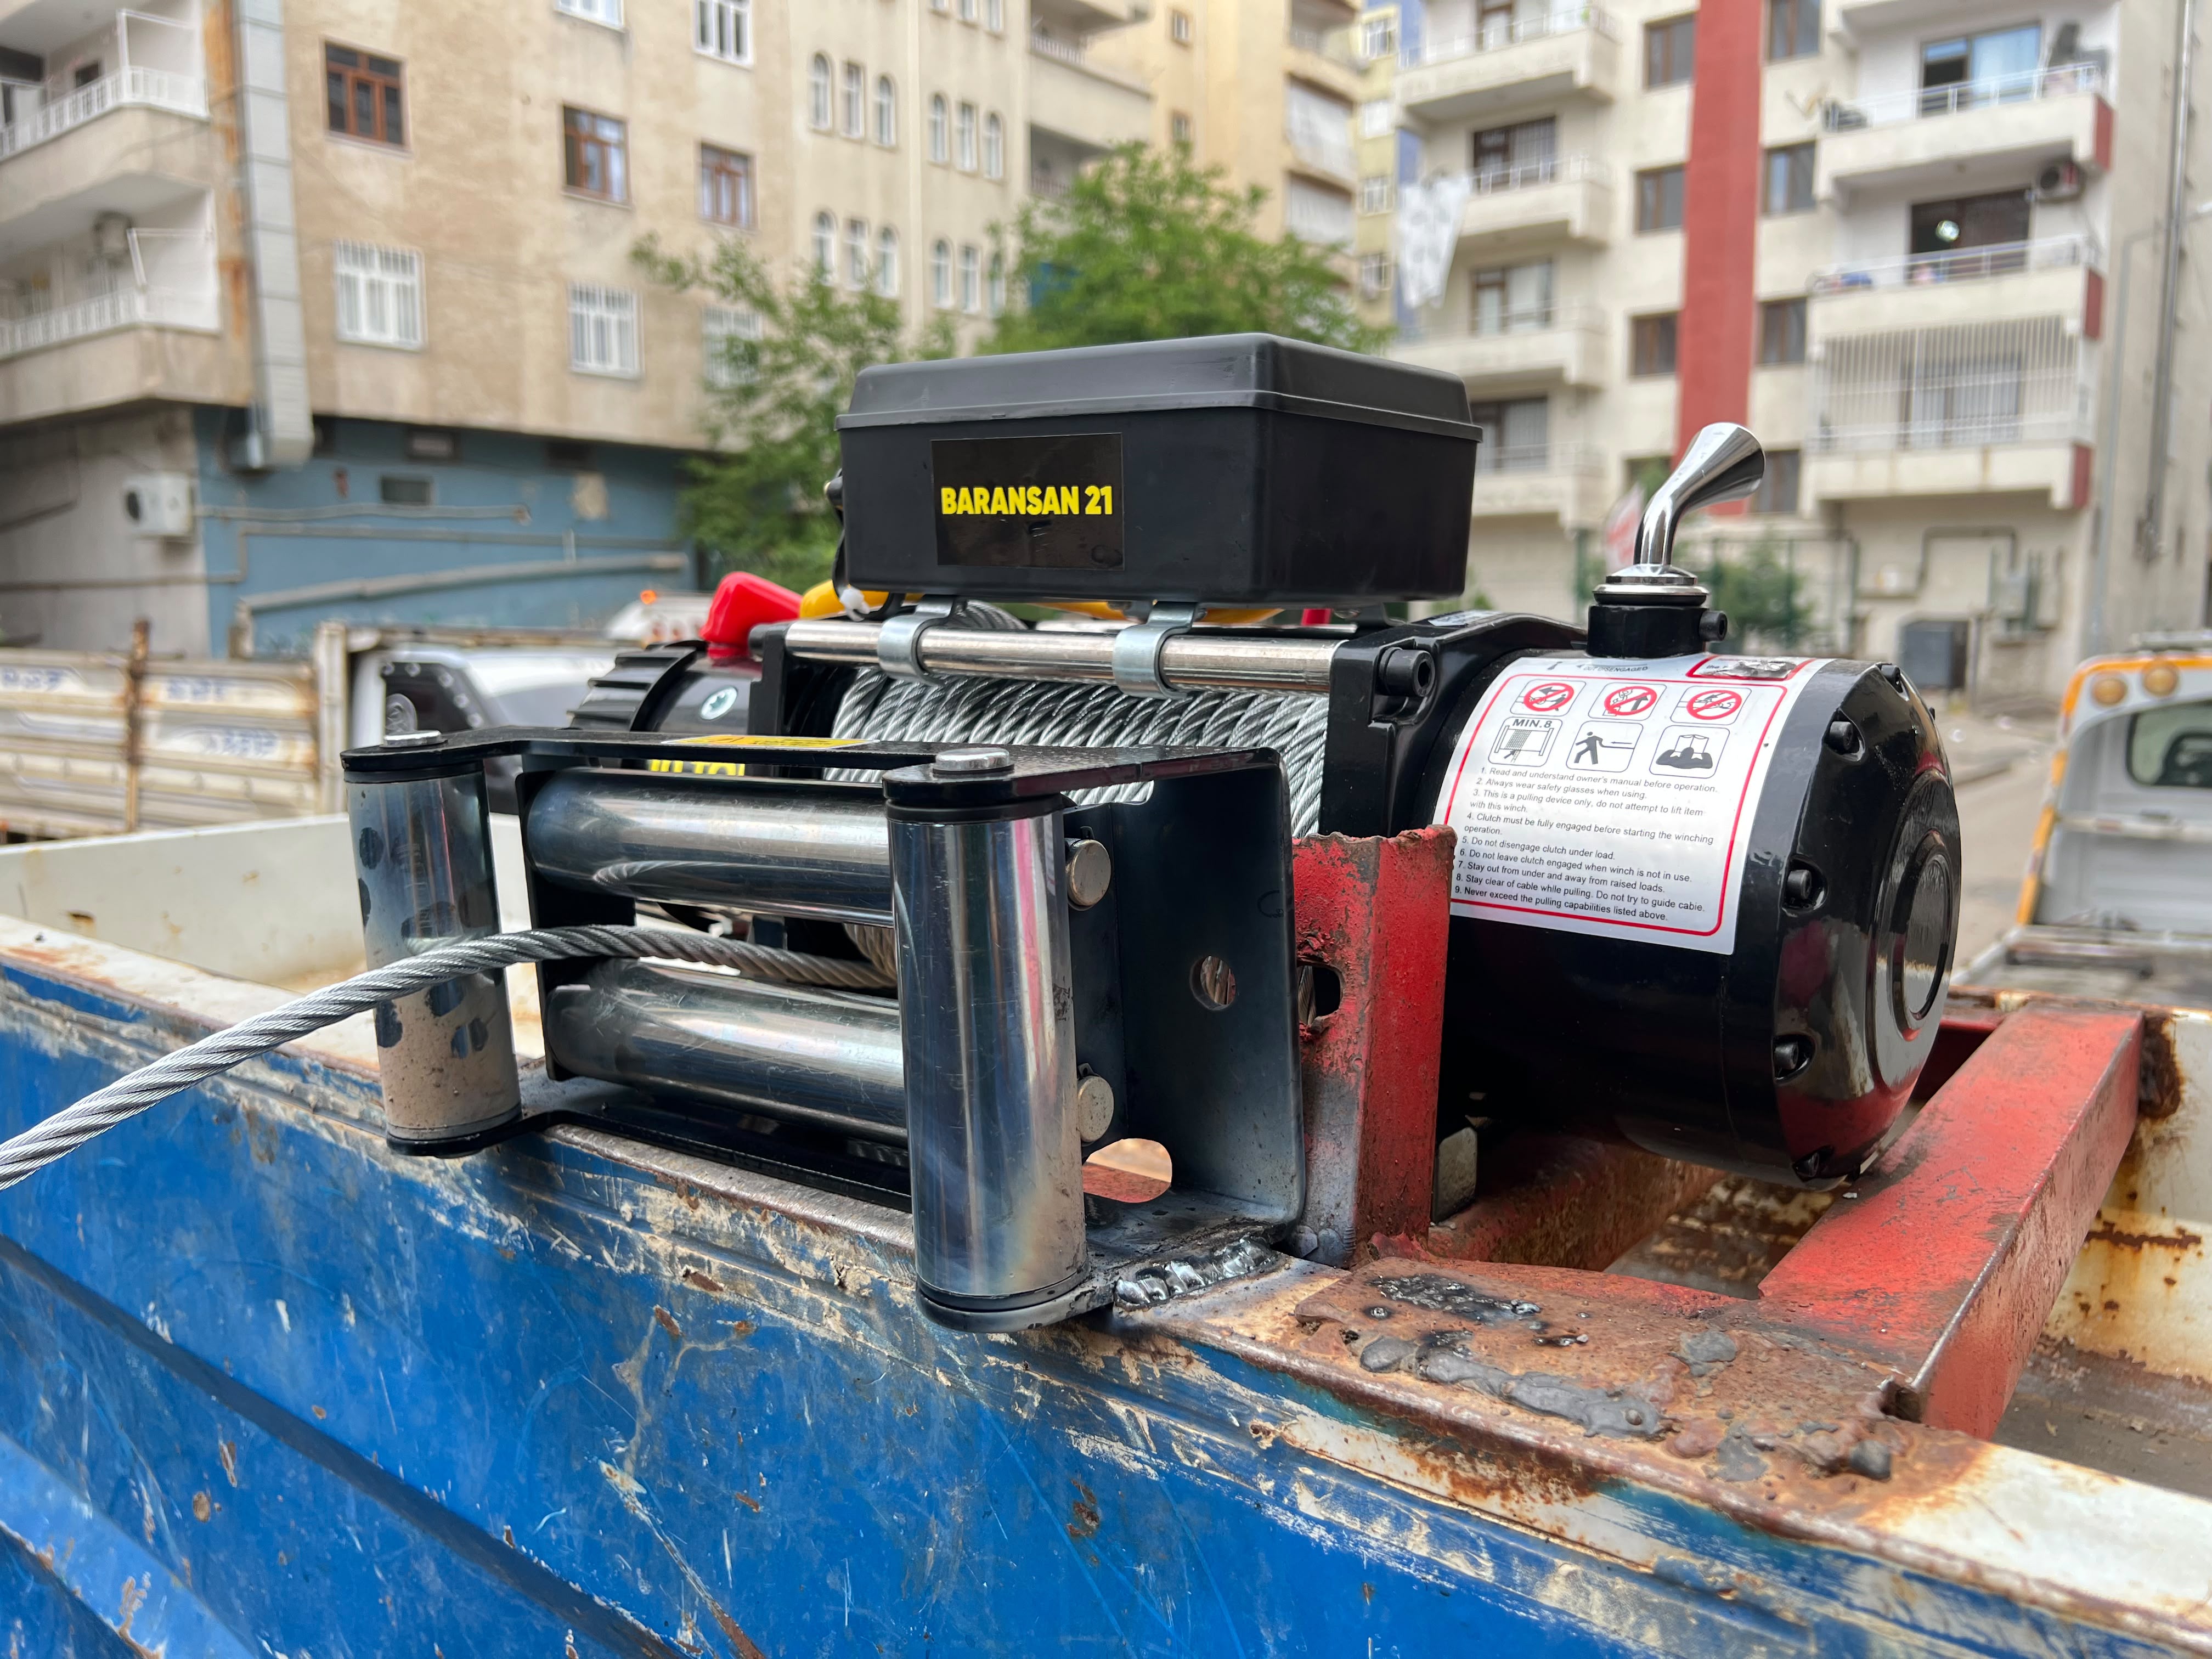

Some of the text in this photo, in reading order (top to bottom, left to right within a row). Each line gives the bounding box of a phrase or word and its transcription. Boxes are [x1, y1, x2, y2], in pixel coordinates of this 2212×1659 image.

[941, 485, 1113, 515] BARANSAN 21
[1485, 777, 1514, 788] Always
[1536, 782, 1562, 793] safety
[1562, 785, 1594, 794] glasses
[1596, 787, 1620, 796] when
[1621, 789, 1646, 800] using.
[1488, 766, 1511, 776] Read
[1528, 771, 1575, 781] understand
[1576, 775, 1608, 784] owner's
[1609, 778, 1642, 786] manual
[1643, 778, 1672, 789] before
[1673, 783, 1717, 792] operation.
[1469, 800, 1528, 812] with this winch.
[1483, 789, 1499, 798] This
[1500, 791, 1508, 799] is
[1516, 793, 1543, 804] pulling
[1545, 794, 1572, 804] device
[1573, 798, 1593, 808] only,
[1595, 799, 1607, 808] do
[1624, 802, 1658, 814] attempt
[1660, 805, 1668, 813] to
[1670, 805, 1682, 815] lift
[1683, 806, 1703, 816] item
[1464, 825, 1502, 835] operation.
[1476, 812, 1501, 822] Clutch
[1502, 816, 1523, 825] must
[1524, 817, 1535, 826] be
[1536, 818, 1554, 830] fully
[1555, 822, 1592, 832] engaged
[1593, 823, 1621, 834] before
[1622, 827, 1656, 840] starting
[1658, 830, 1672, 839] the
[1674, 833, 1714, 845] winching
[1471, 836, 1483, 845] Do
[1484, 839, 1497, 847] not
[1498, 839, 1541, 853] disengage
[1542, 844, 1566, 855] clutch
[1568, 848, 1594, 857] under
[1594, 849, 1615, 860] load.
[1466, 861, 1485, 873] Stay
[1486, 865, 1499, 873] out
[1501, 865, 1519, 875] from
[1521, 868, 1545, 878] under
[1546, 872, 1562, 881] and
[1564, 874, 1587, 885] away
[1588, 875, 1608, 886] from
[1610, 878, 1637, 889] raised
[1638, 881, 1664, 893] loads.
[1469, 848, 1481, 858] Do
[1482, 851, 1495, 860] not
[1496, 851, 1518, 862] leave
[1520, 855, 1544, 865] clutch
[1546, 859, 1583, 871] engaged
[1584, 862, 1607, 872] when
[1609, 865, 1634, 876] winch
[1636, 867, 1644, 877] is
[1645, 870, 1661, 879] not
[1662, 870, 1671, 880] in
[1673, 873, 1691, 883] use.
[1464, 885, 1488, 897] Never
[1489, 891, 1518, 901] exceed
[1520, 894, 1533, 903] the
[1534, 896, 1562, 909] pulling
[1564, 901, 1611, 913] capabilities
[1613, 905, 1637, 917] listed
[1638, 909, 1667, 921] above.
[1465, 873, 1483, 885] Stay
[1485, 877, 1505, 886] clear
[1506, 879, 1515, 888] of
[1516, 881, 1538, 891] cable
[1540, 883, 1561, 894] while
[1595, 889, 1609, 900] Do
[1610, 893, 1624, 902] not
[1626, 894, 1638, 905] try
[1640, 896, 1649, 905] to
[1651, 898, 1675, 908] guide
